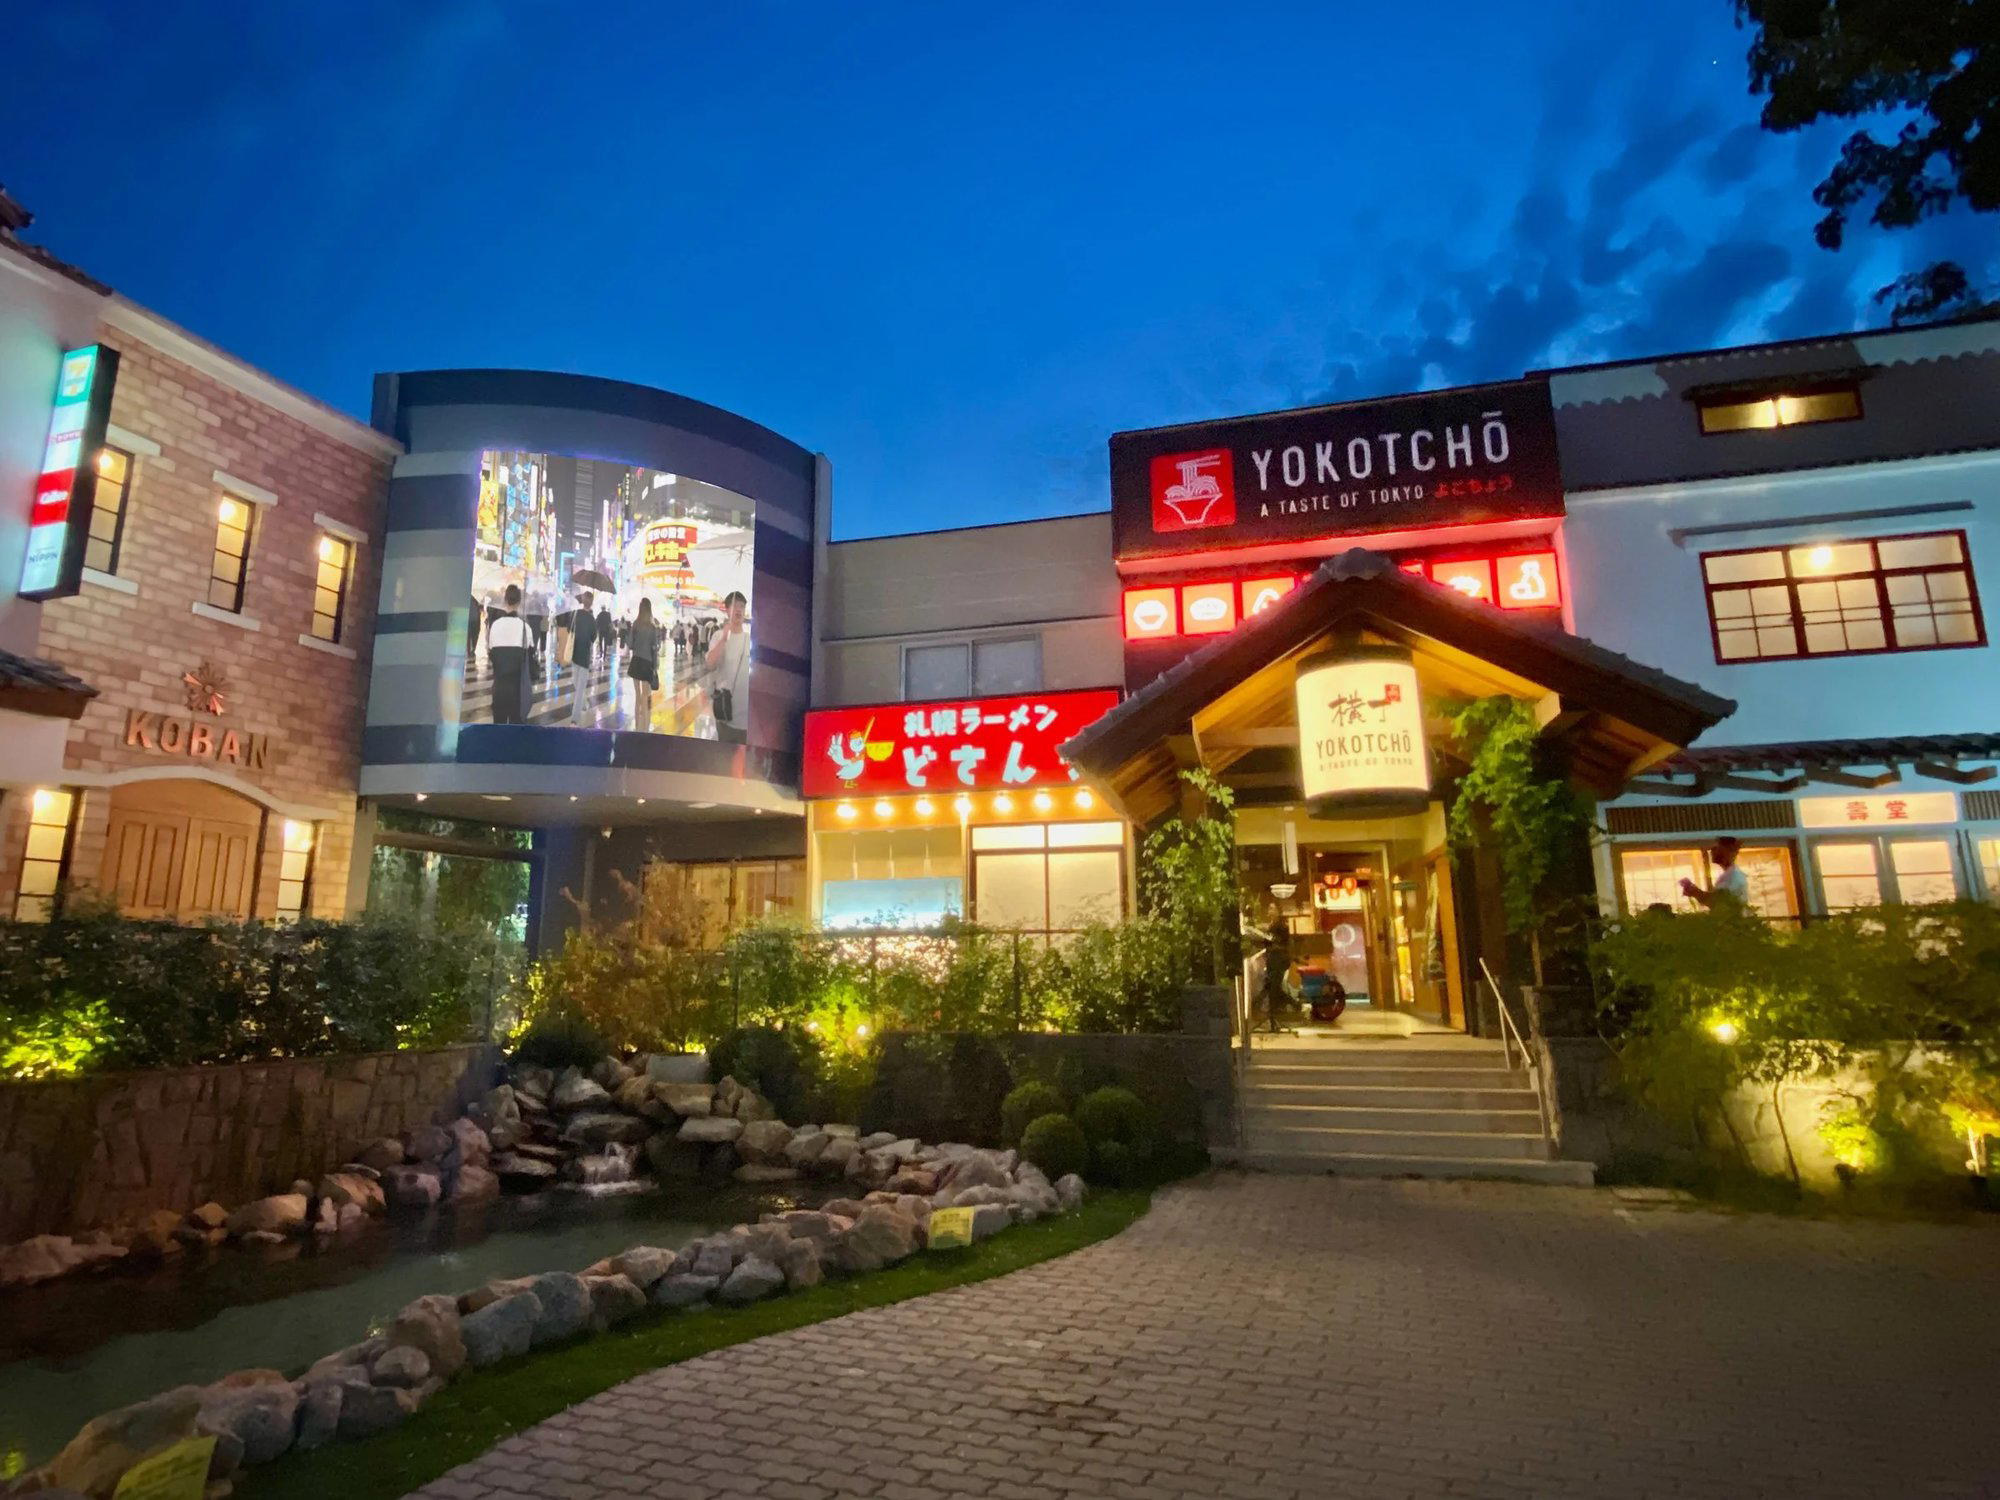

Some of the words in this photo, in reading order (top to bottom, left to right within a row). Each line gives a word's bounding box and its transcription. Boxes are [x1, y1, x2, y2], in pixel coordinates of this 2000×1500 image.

[1251, 410, 1510, 491] YOKOTCHŌ
[1260, 503, 1269, 517] A
[1279, 495, 1331, 515] TASTE
[1340, 491, 1360, 508] OF
[1371, 485, 1424, 504] TOKYO
[125, 709, 273, 769] KOBAN
[904, 704, 1058, 738] 札幌ラーメン
[902, 739, 1080, 787] どさん
